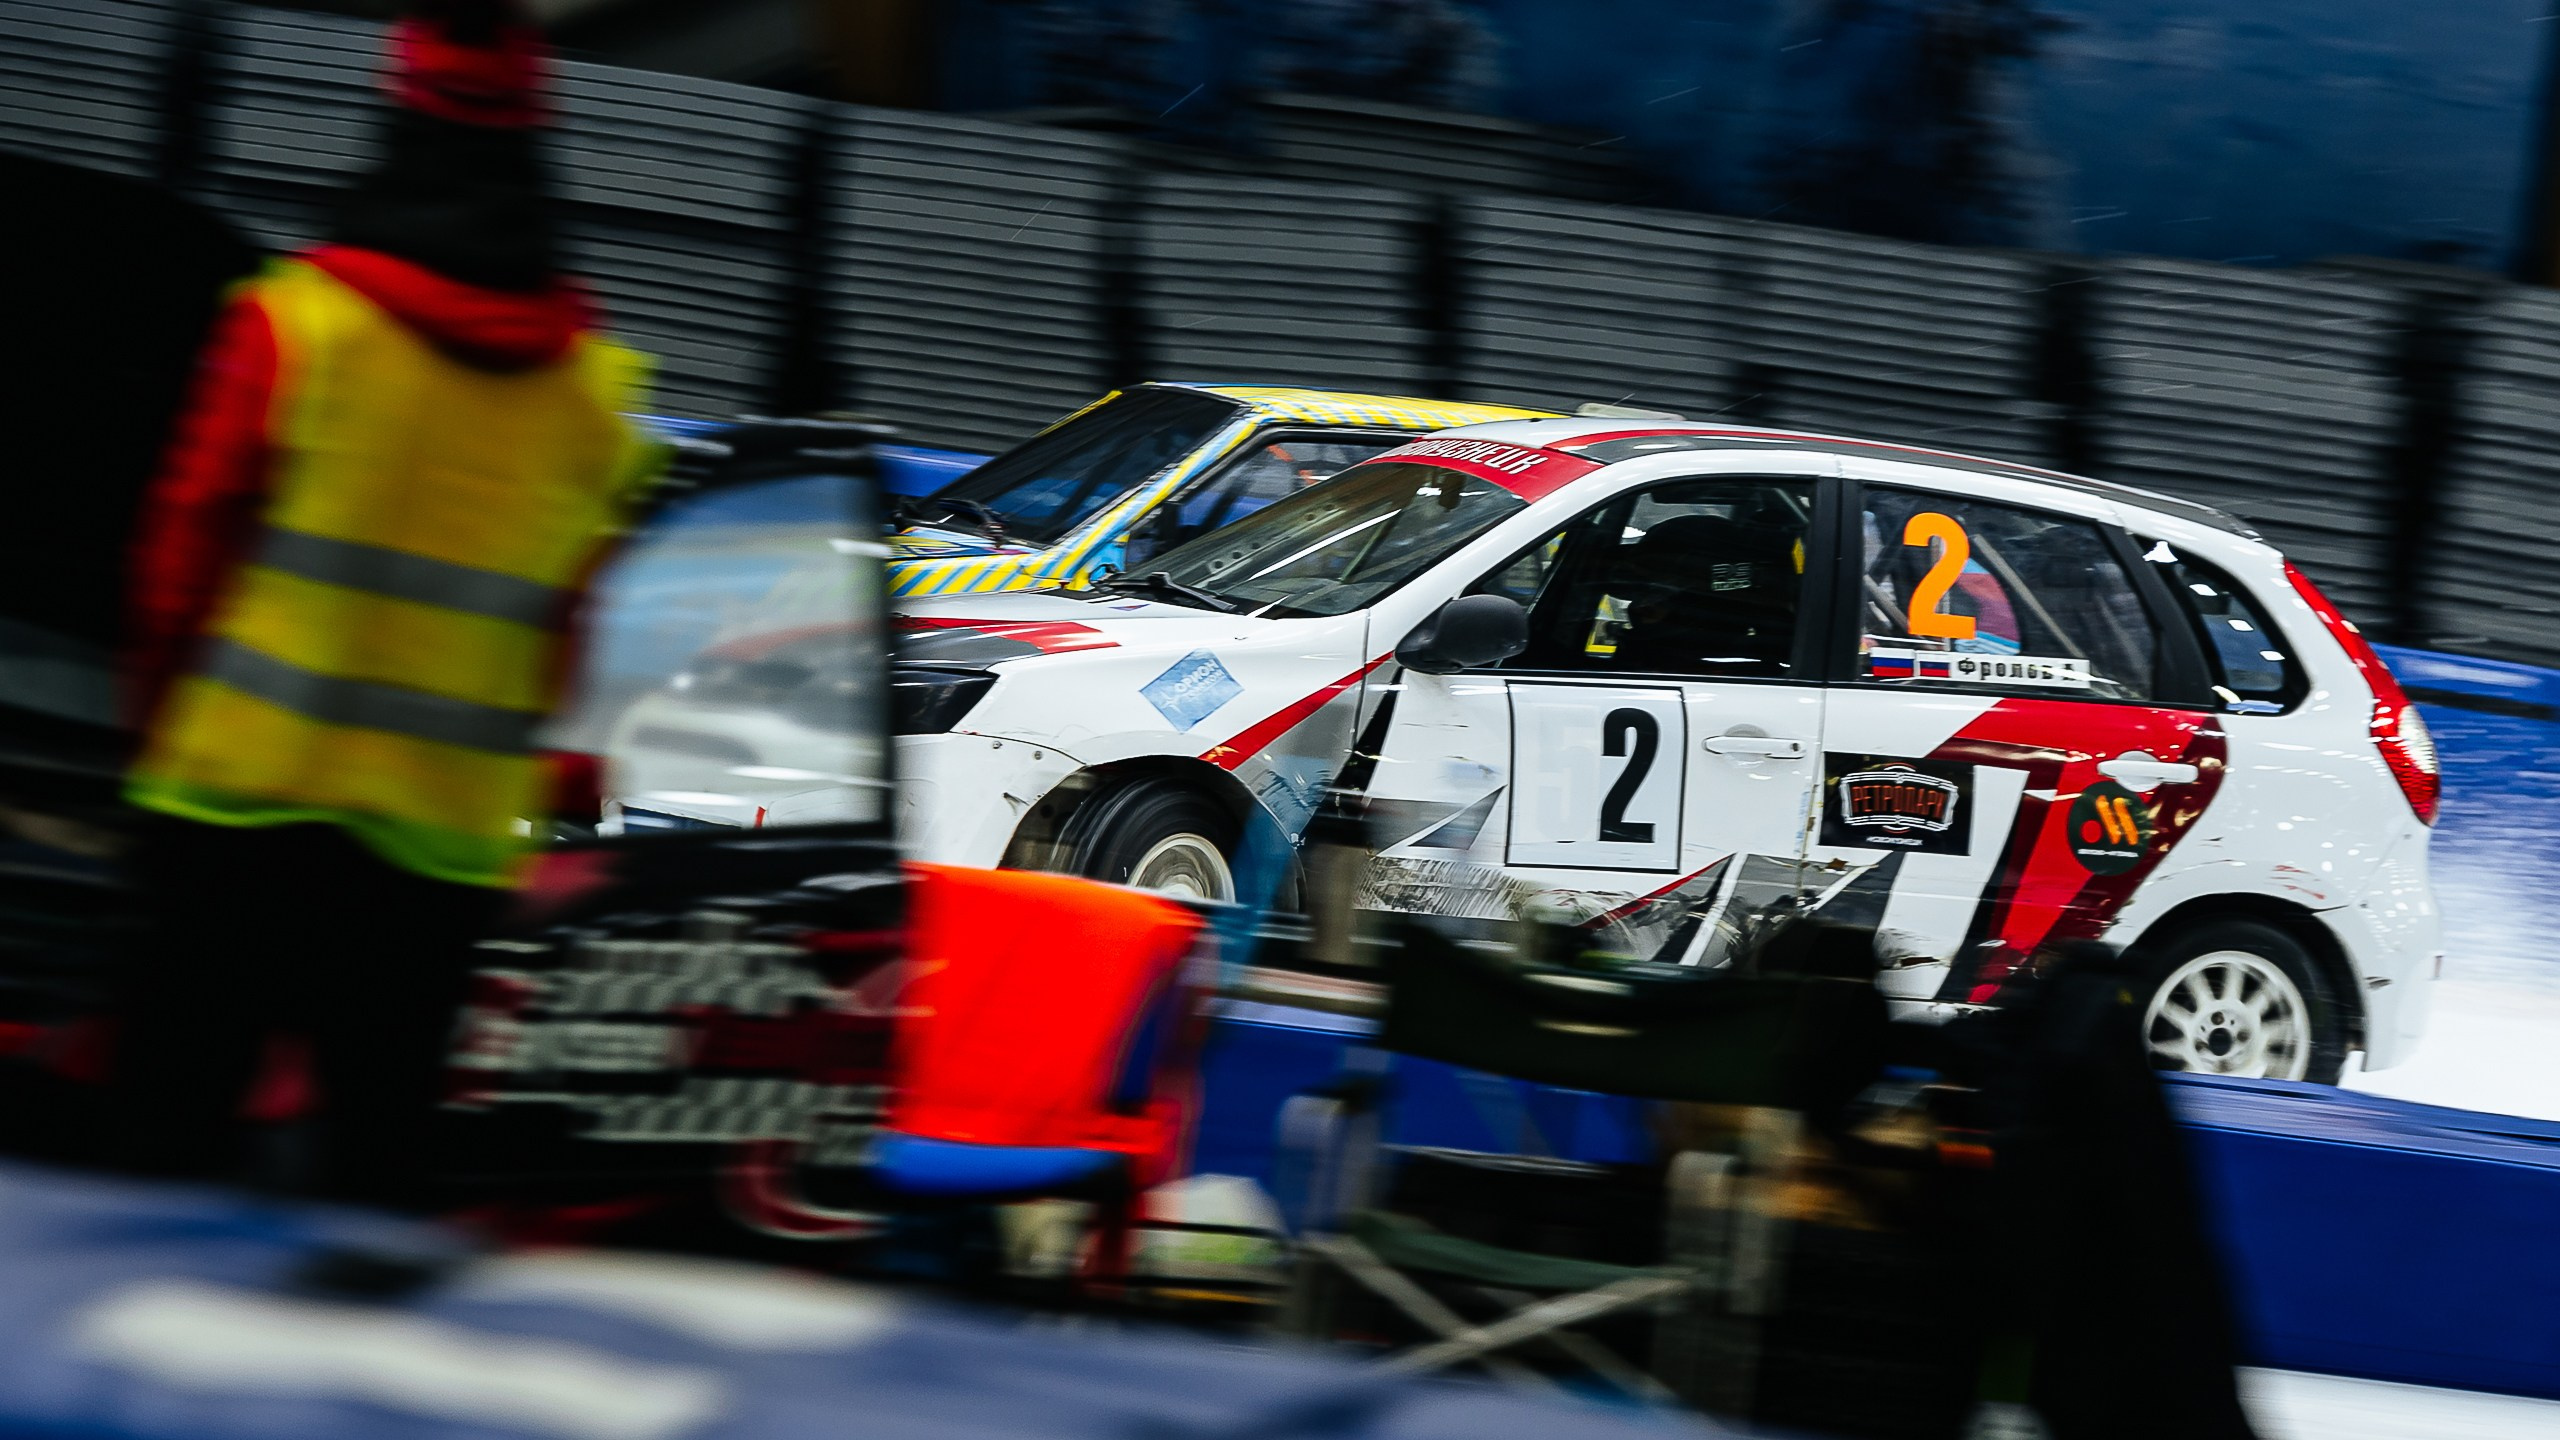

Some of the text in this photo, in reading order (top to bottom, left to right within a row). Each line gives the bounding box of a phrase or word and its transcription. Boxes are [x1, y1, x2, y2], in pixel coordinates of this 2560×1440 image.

[1903, 512, 1976, 639] 2
[1174, 659, 1219, 693] ОРИОН
[1599, 707, 1659, 843] 2
